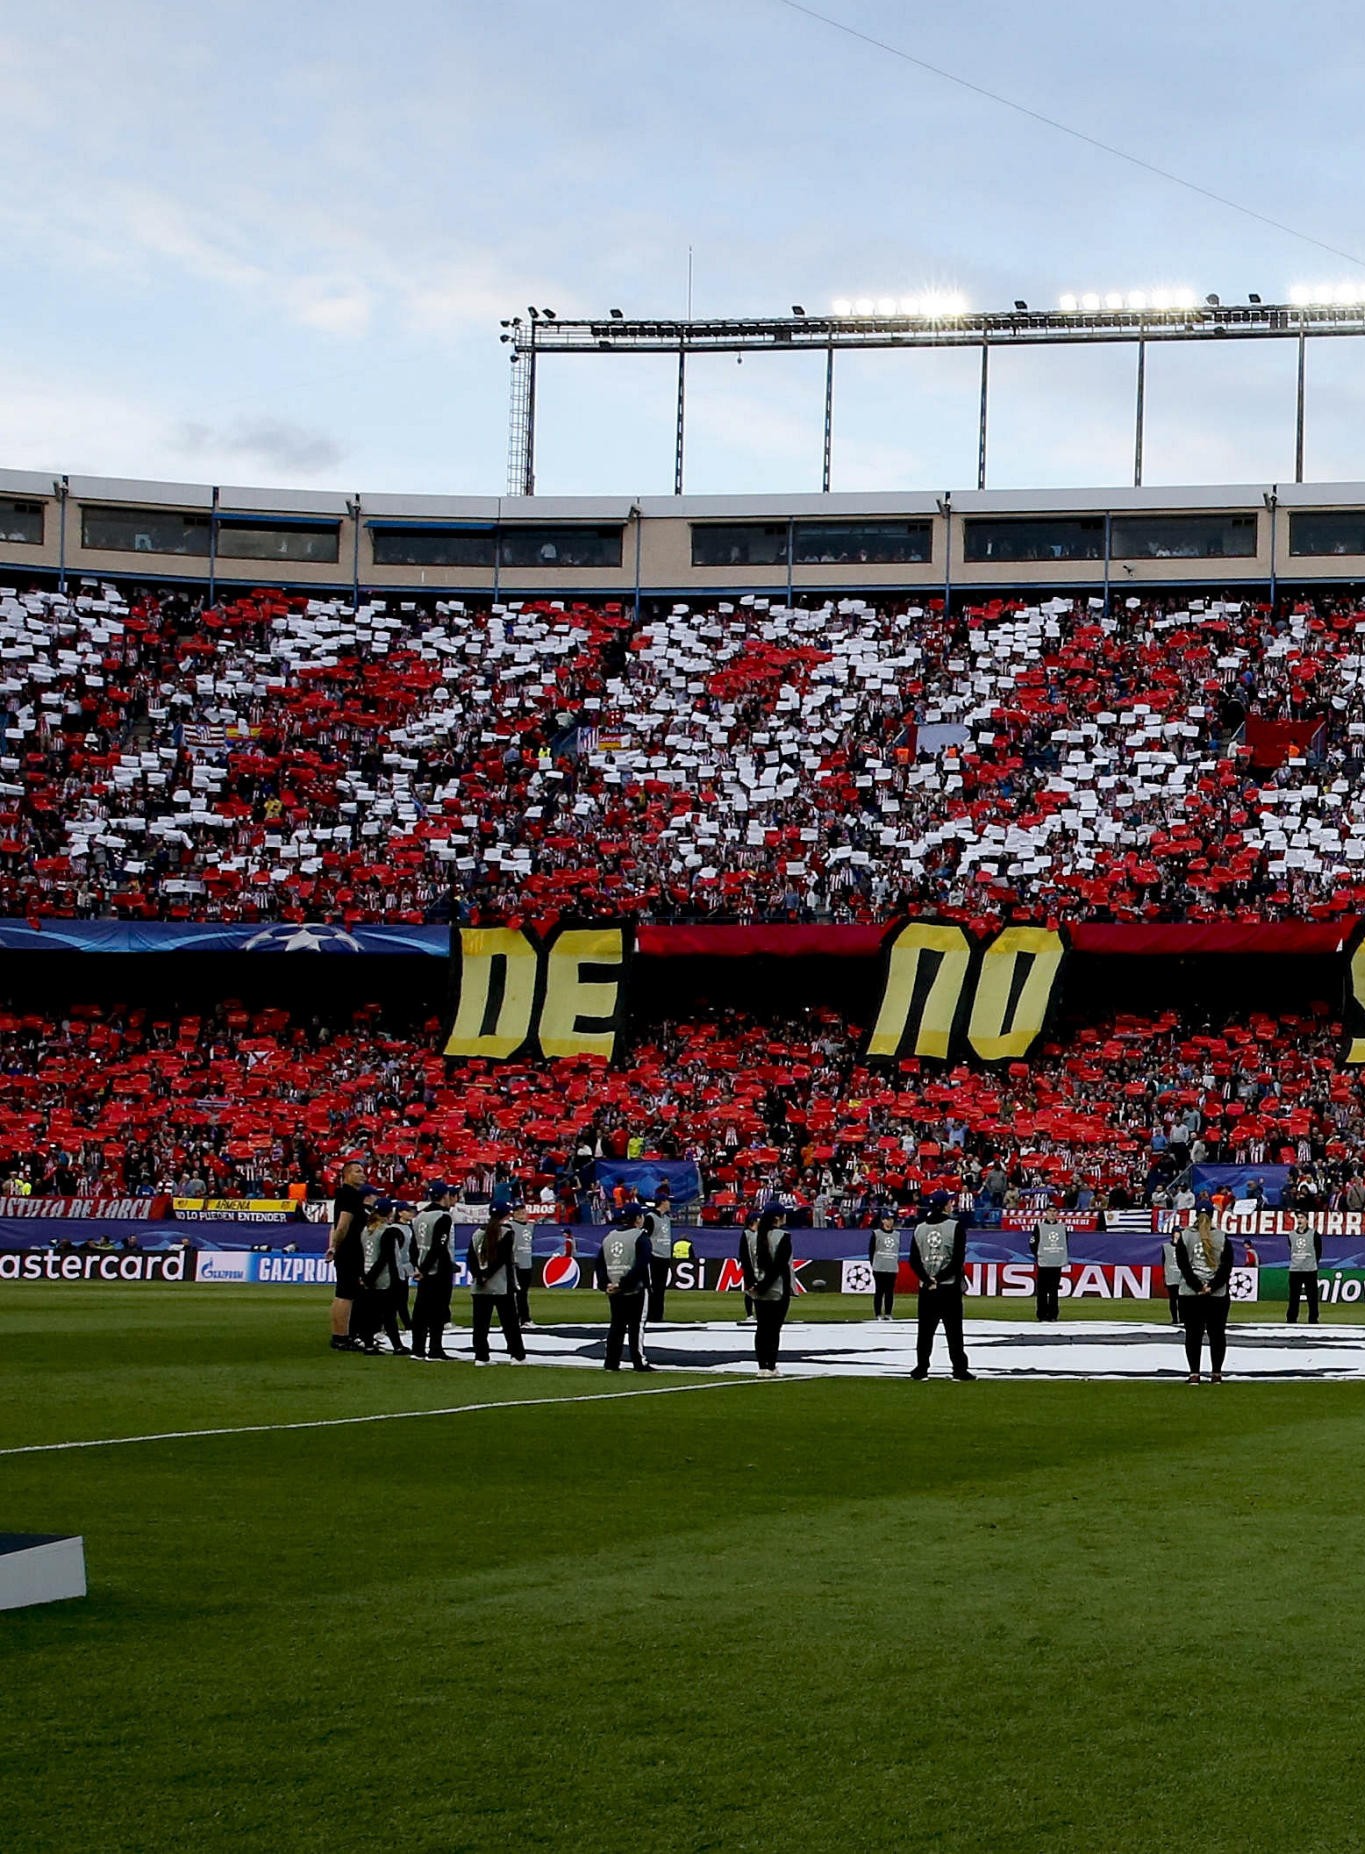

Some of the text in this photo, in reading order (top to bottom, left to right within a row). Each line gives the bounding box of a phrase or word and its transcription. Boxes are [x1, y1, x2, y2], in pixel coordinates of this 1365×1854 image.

[444, 926, 624, 1061] DE
[867, 922, 1065, 1059] NO
[187, 1211, 198, 1220] LO
[200, 1211, 234, 1221] PUEDEN
[238, 1212, 287, 1222] ENTENDER
